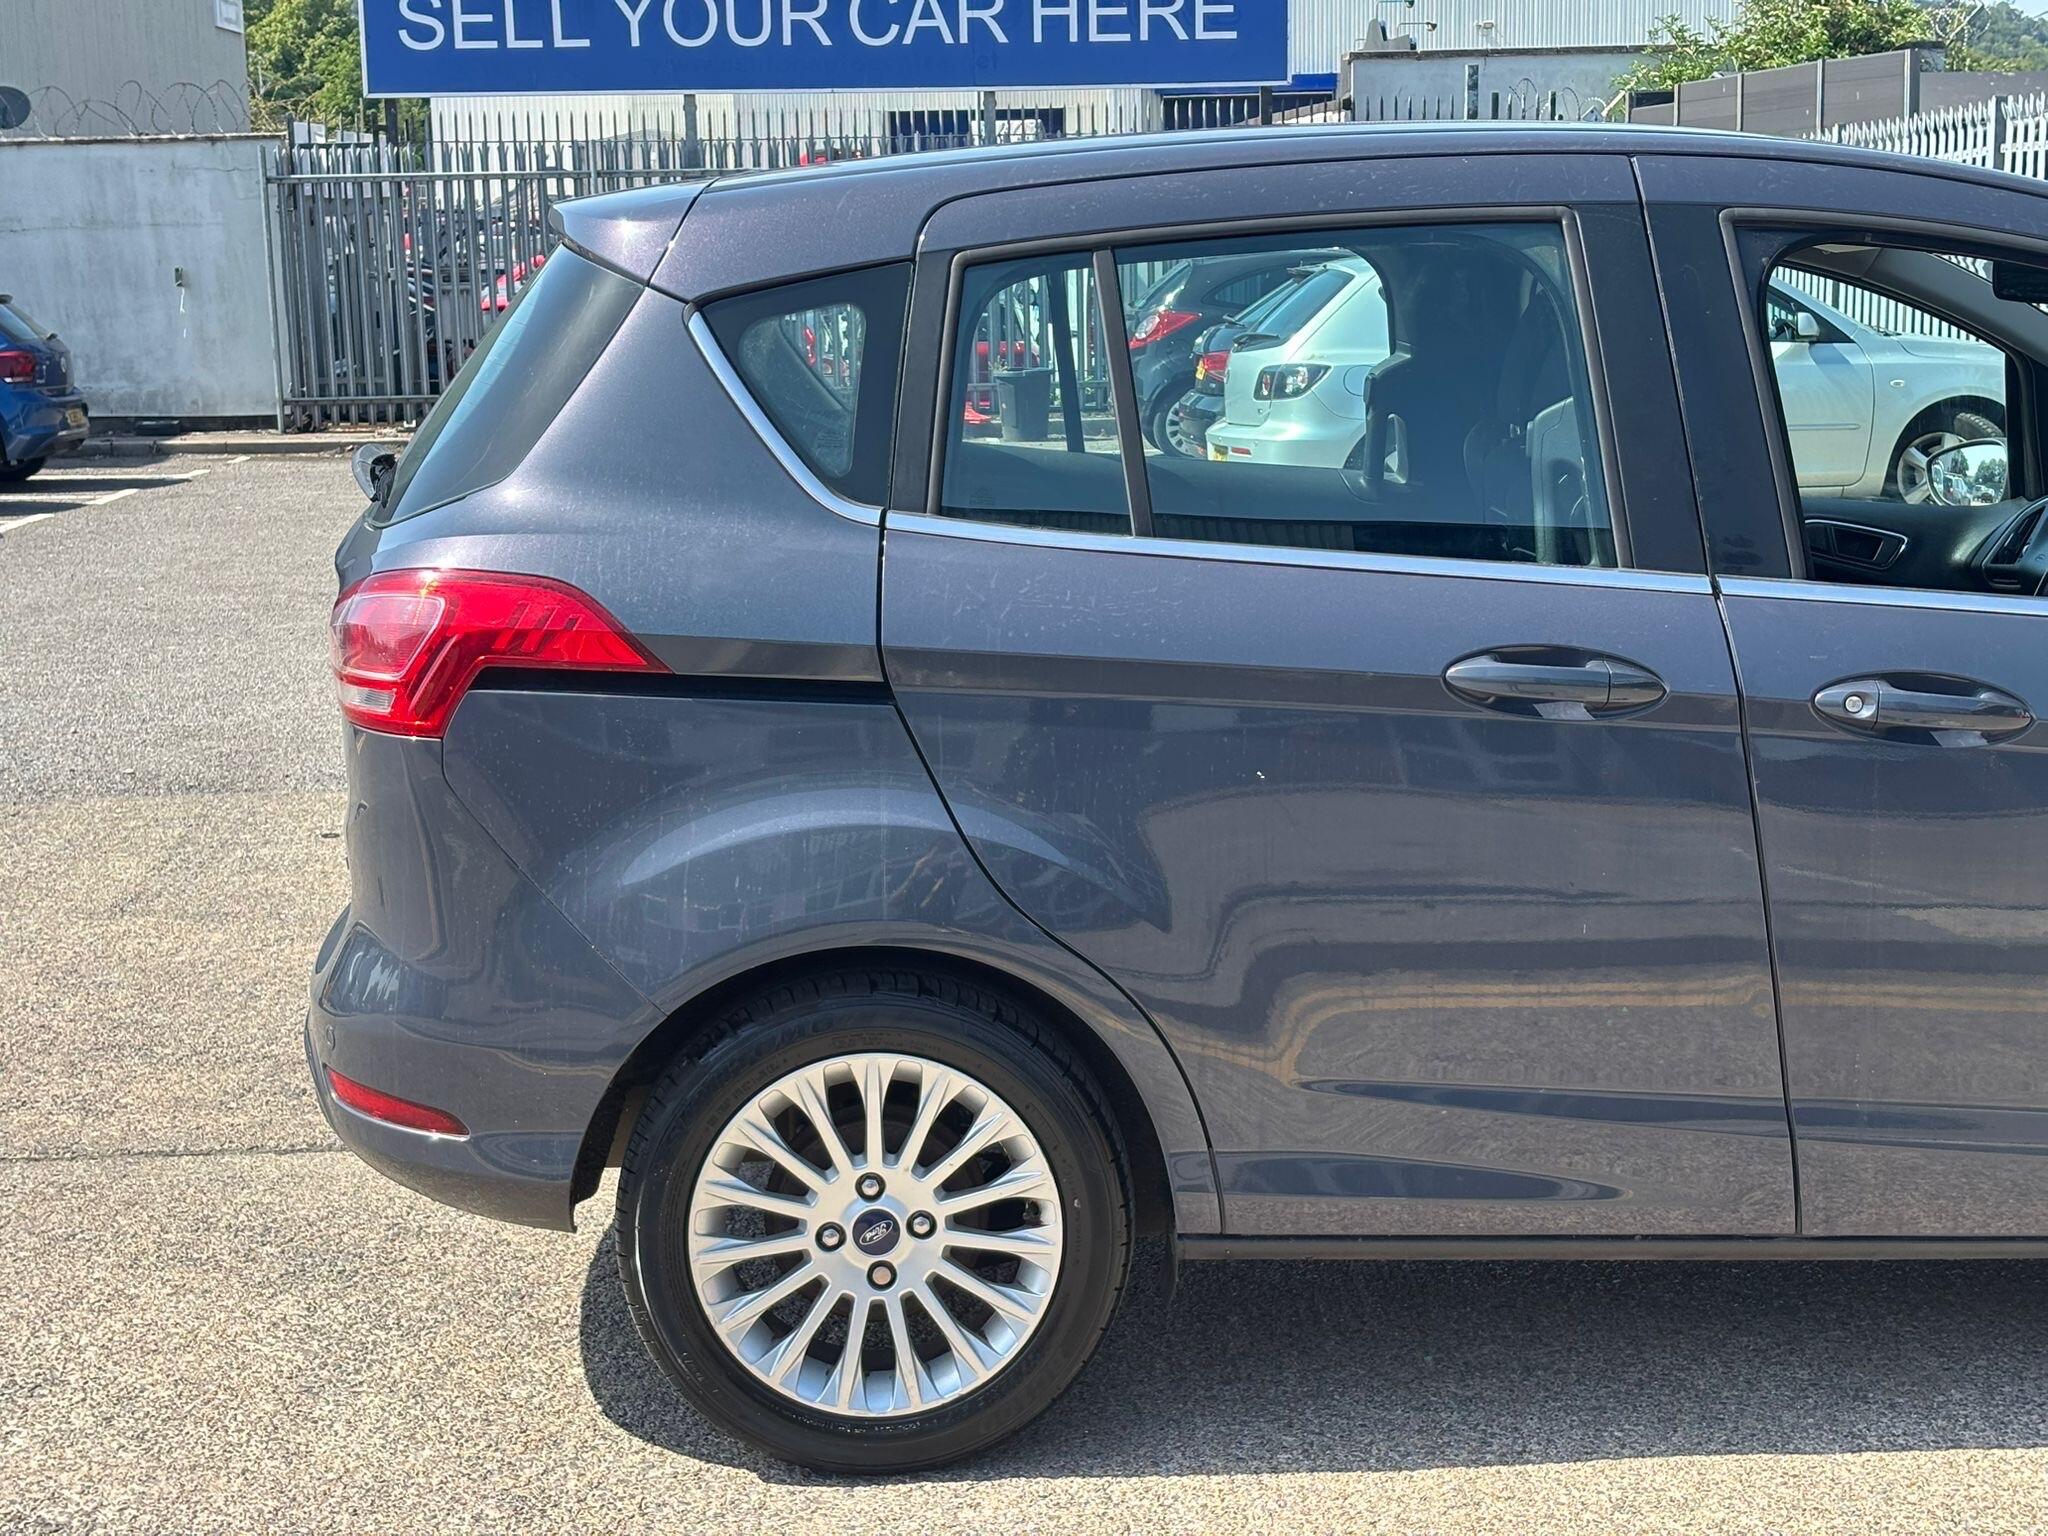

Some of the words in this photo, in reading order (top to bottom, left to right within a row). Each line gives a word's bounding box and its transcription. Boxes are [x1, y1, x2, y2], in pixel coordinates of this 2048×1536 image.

[398, 0, 591, 51] SELL
[615, 0, 833, 47] YOUR
[849, 0, 1009, 46] CAR
[1033, 0, 1238, 43] HERE
